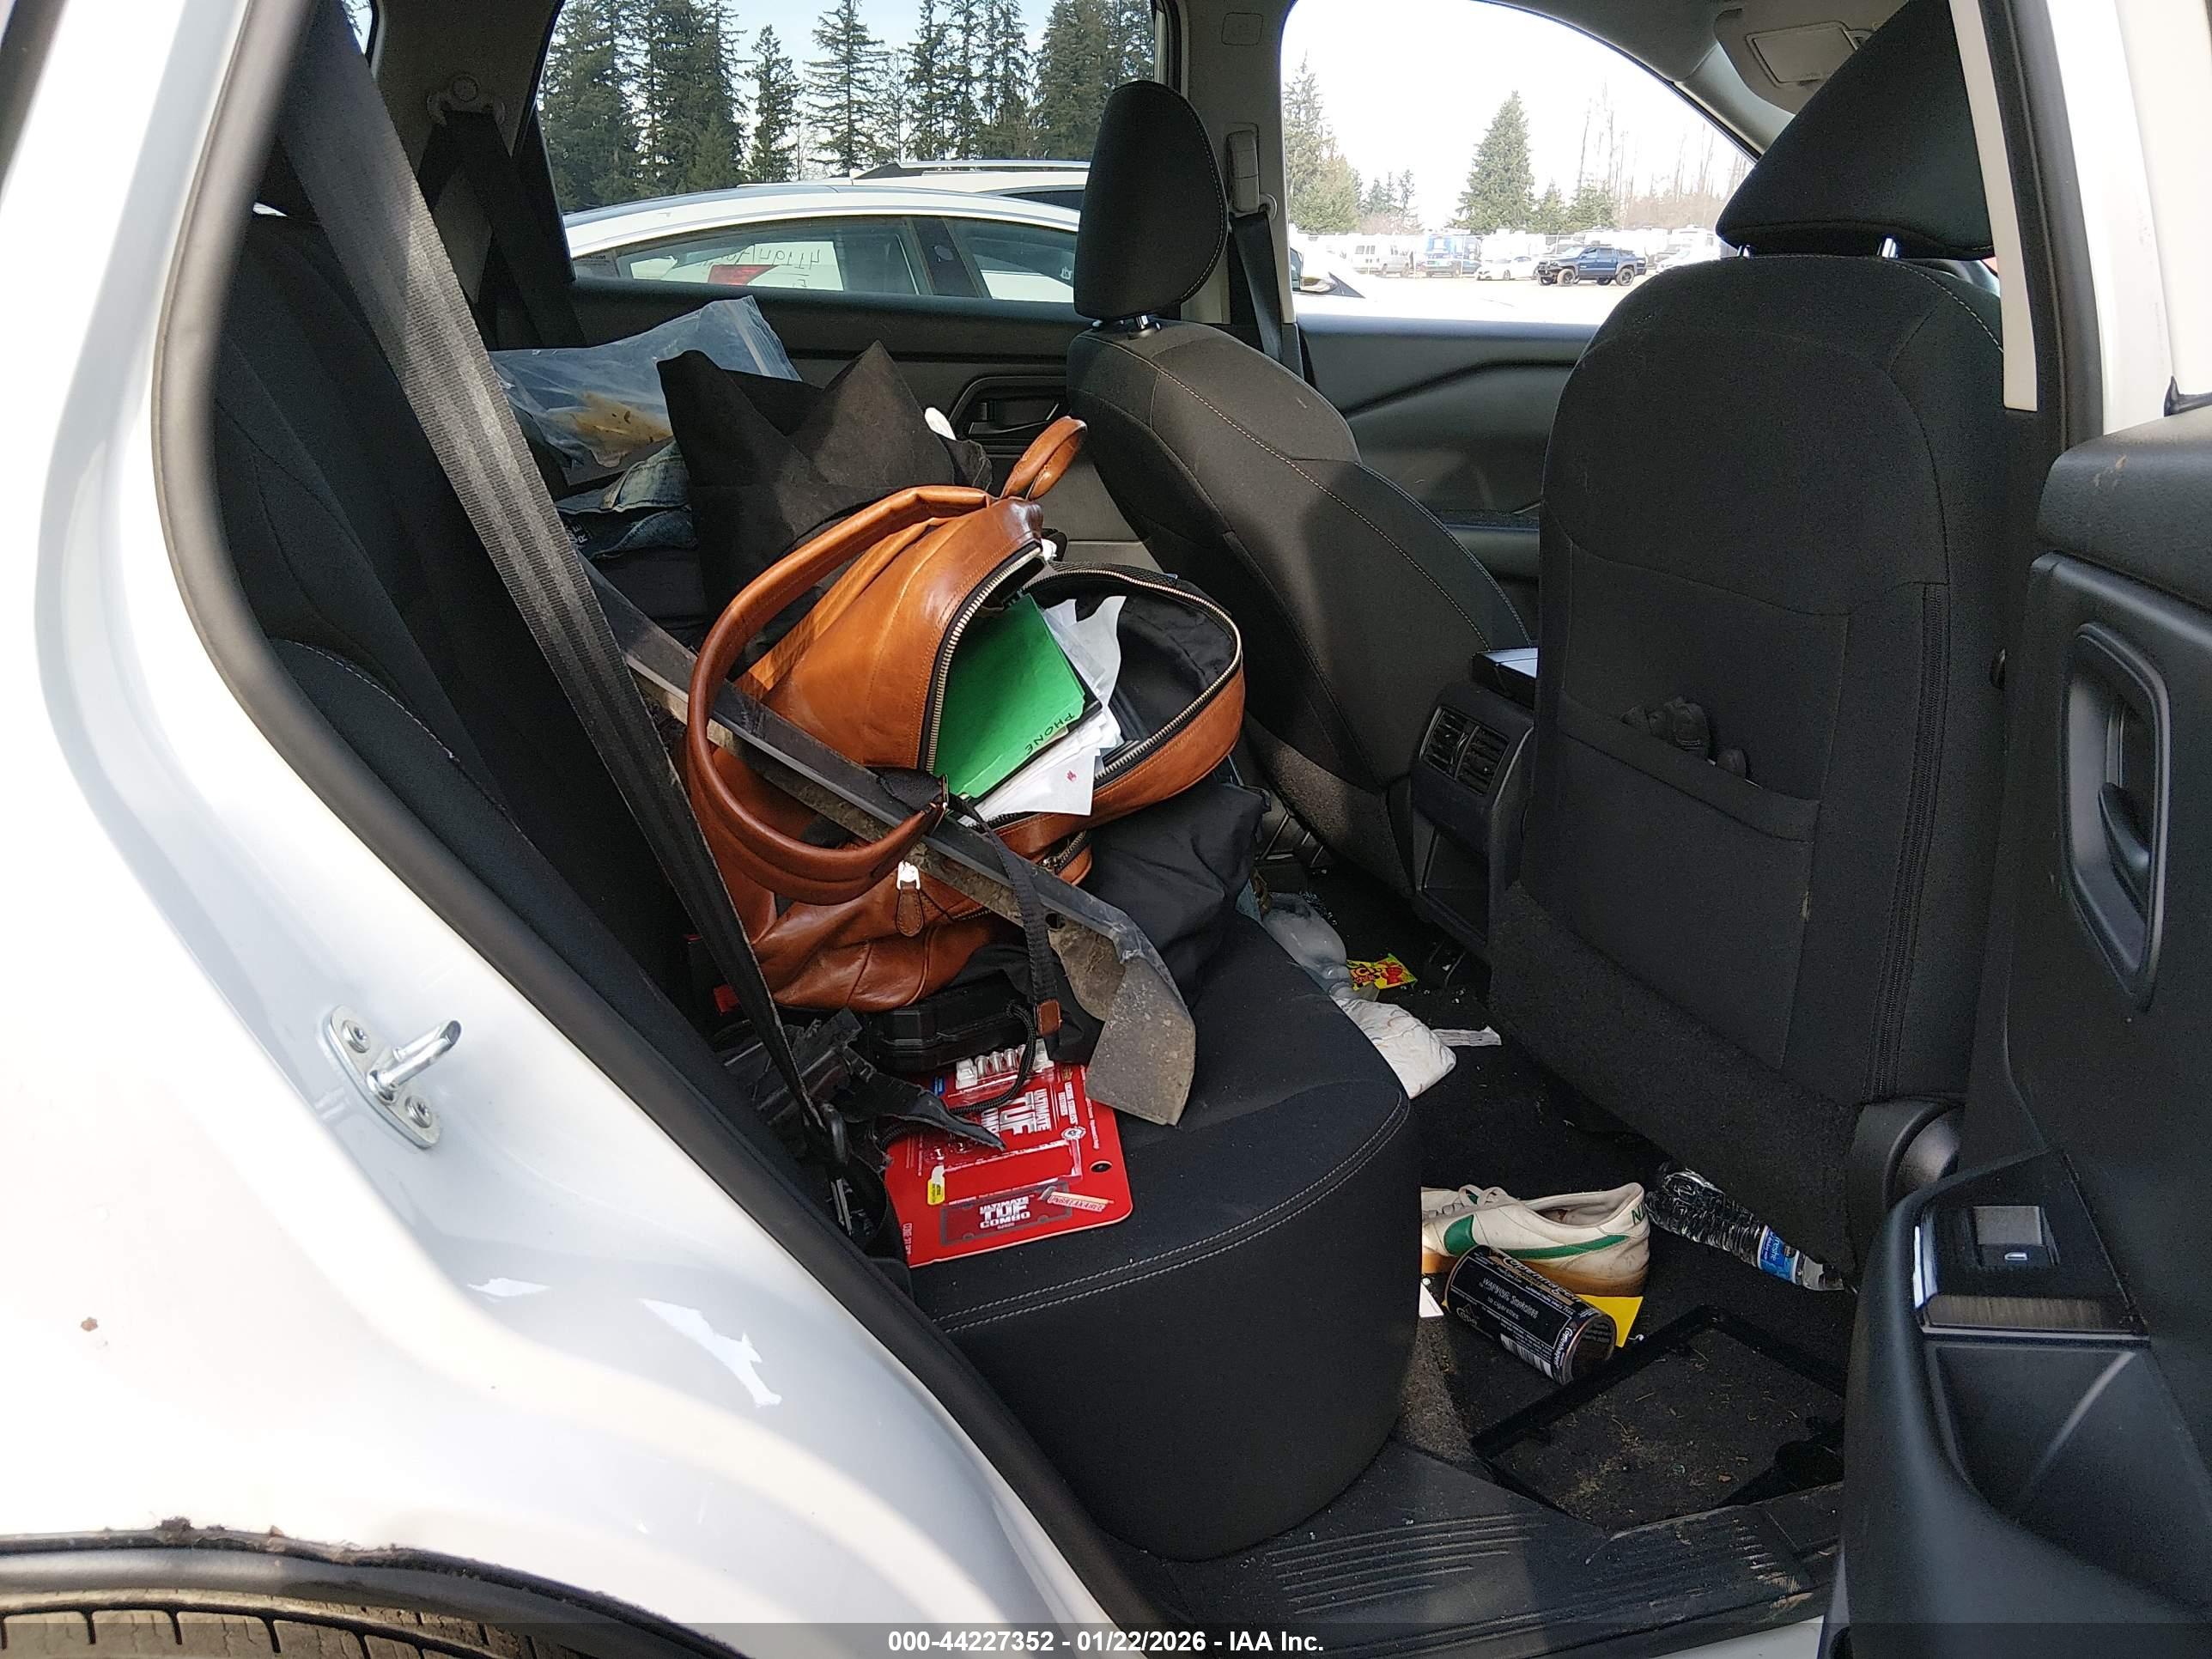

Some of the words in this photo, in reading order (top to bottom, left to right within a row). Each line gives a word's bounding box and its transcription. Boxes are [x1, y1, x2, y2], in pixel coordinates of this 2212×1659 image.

[1024, 713, 1075, 756] PHONE
[994, 1091, 1036, 1135] TUF
[1033, 1088, 1052, 1131] ULTIMATE
[978, 1212, 1030, 1230] COMBO
[979, 1196, 1030, 1215] ULTIMATE
[981, 1202, 1028, 1223] TUF
